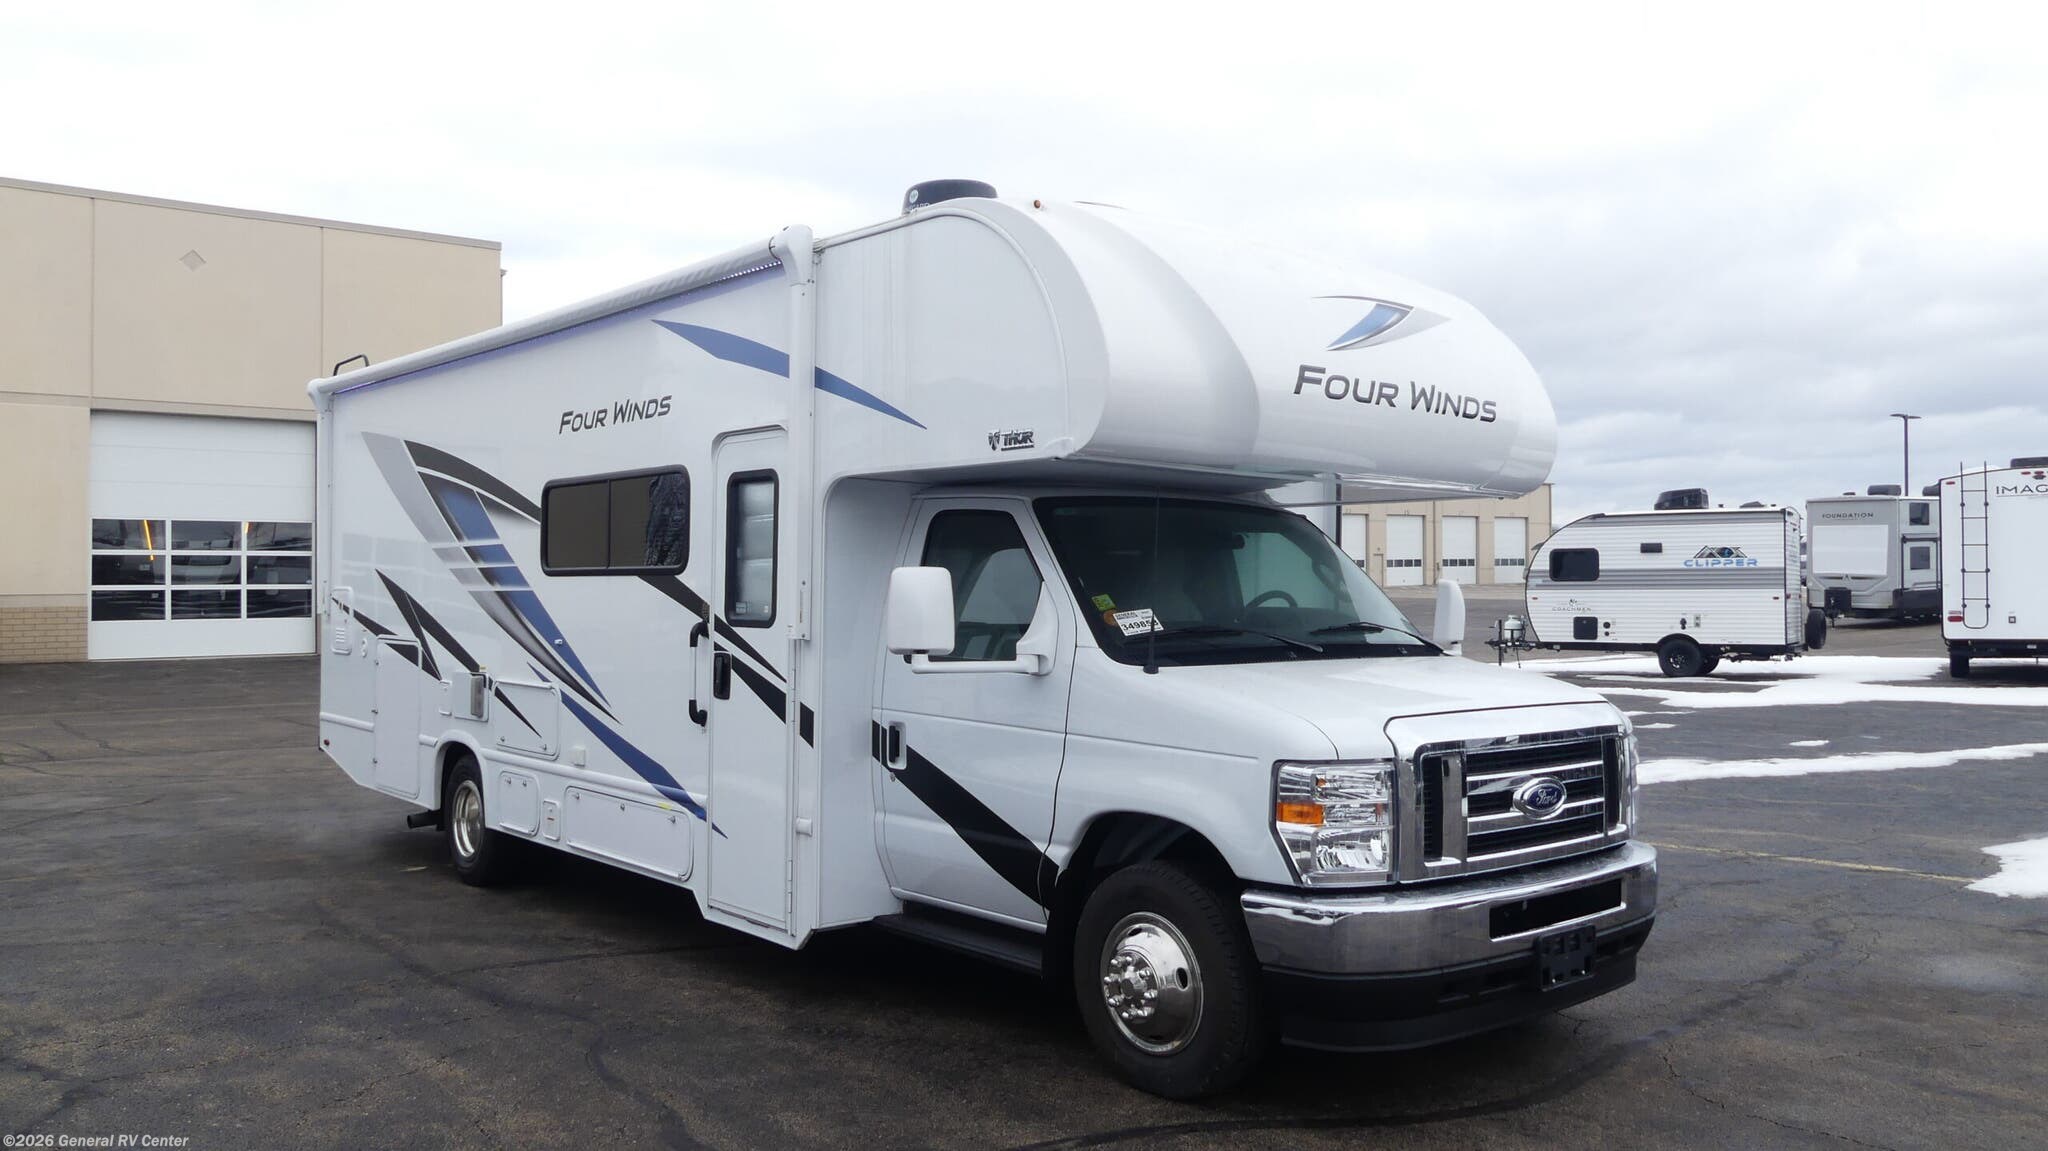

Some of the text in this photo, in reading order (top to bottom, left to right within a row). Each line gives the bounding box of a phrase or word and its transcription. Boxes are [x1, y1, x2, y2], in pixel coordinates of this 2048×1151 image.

[1293, 364, 1497, 423] FOUR WINDS
[559, 394, 672, 435] FOUR WINDS
[1000, 430, 1034, 446] THOR
[1683, 559, 1758, 567] CLIPPER
[1535, 788, 1559, 805] Ford
